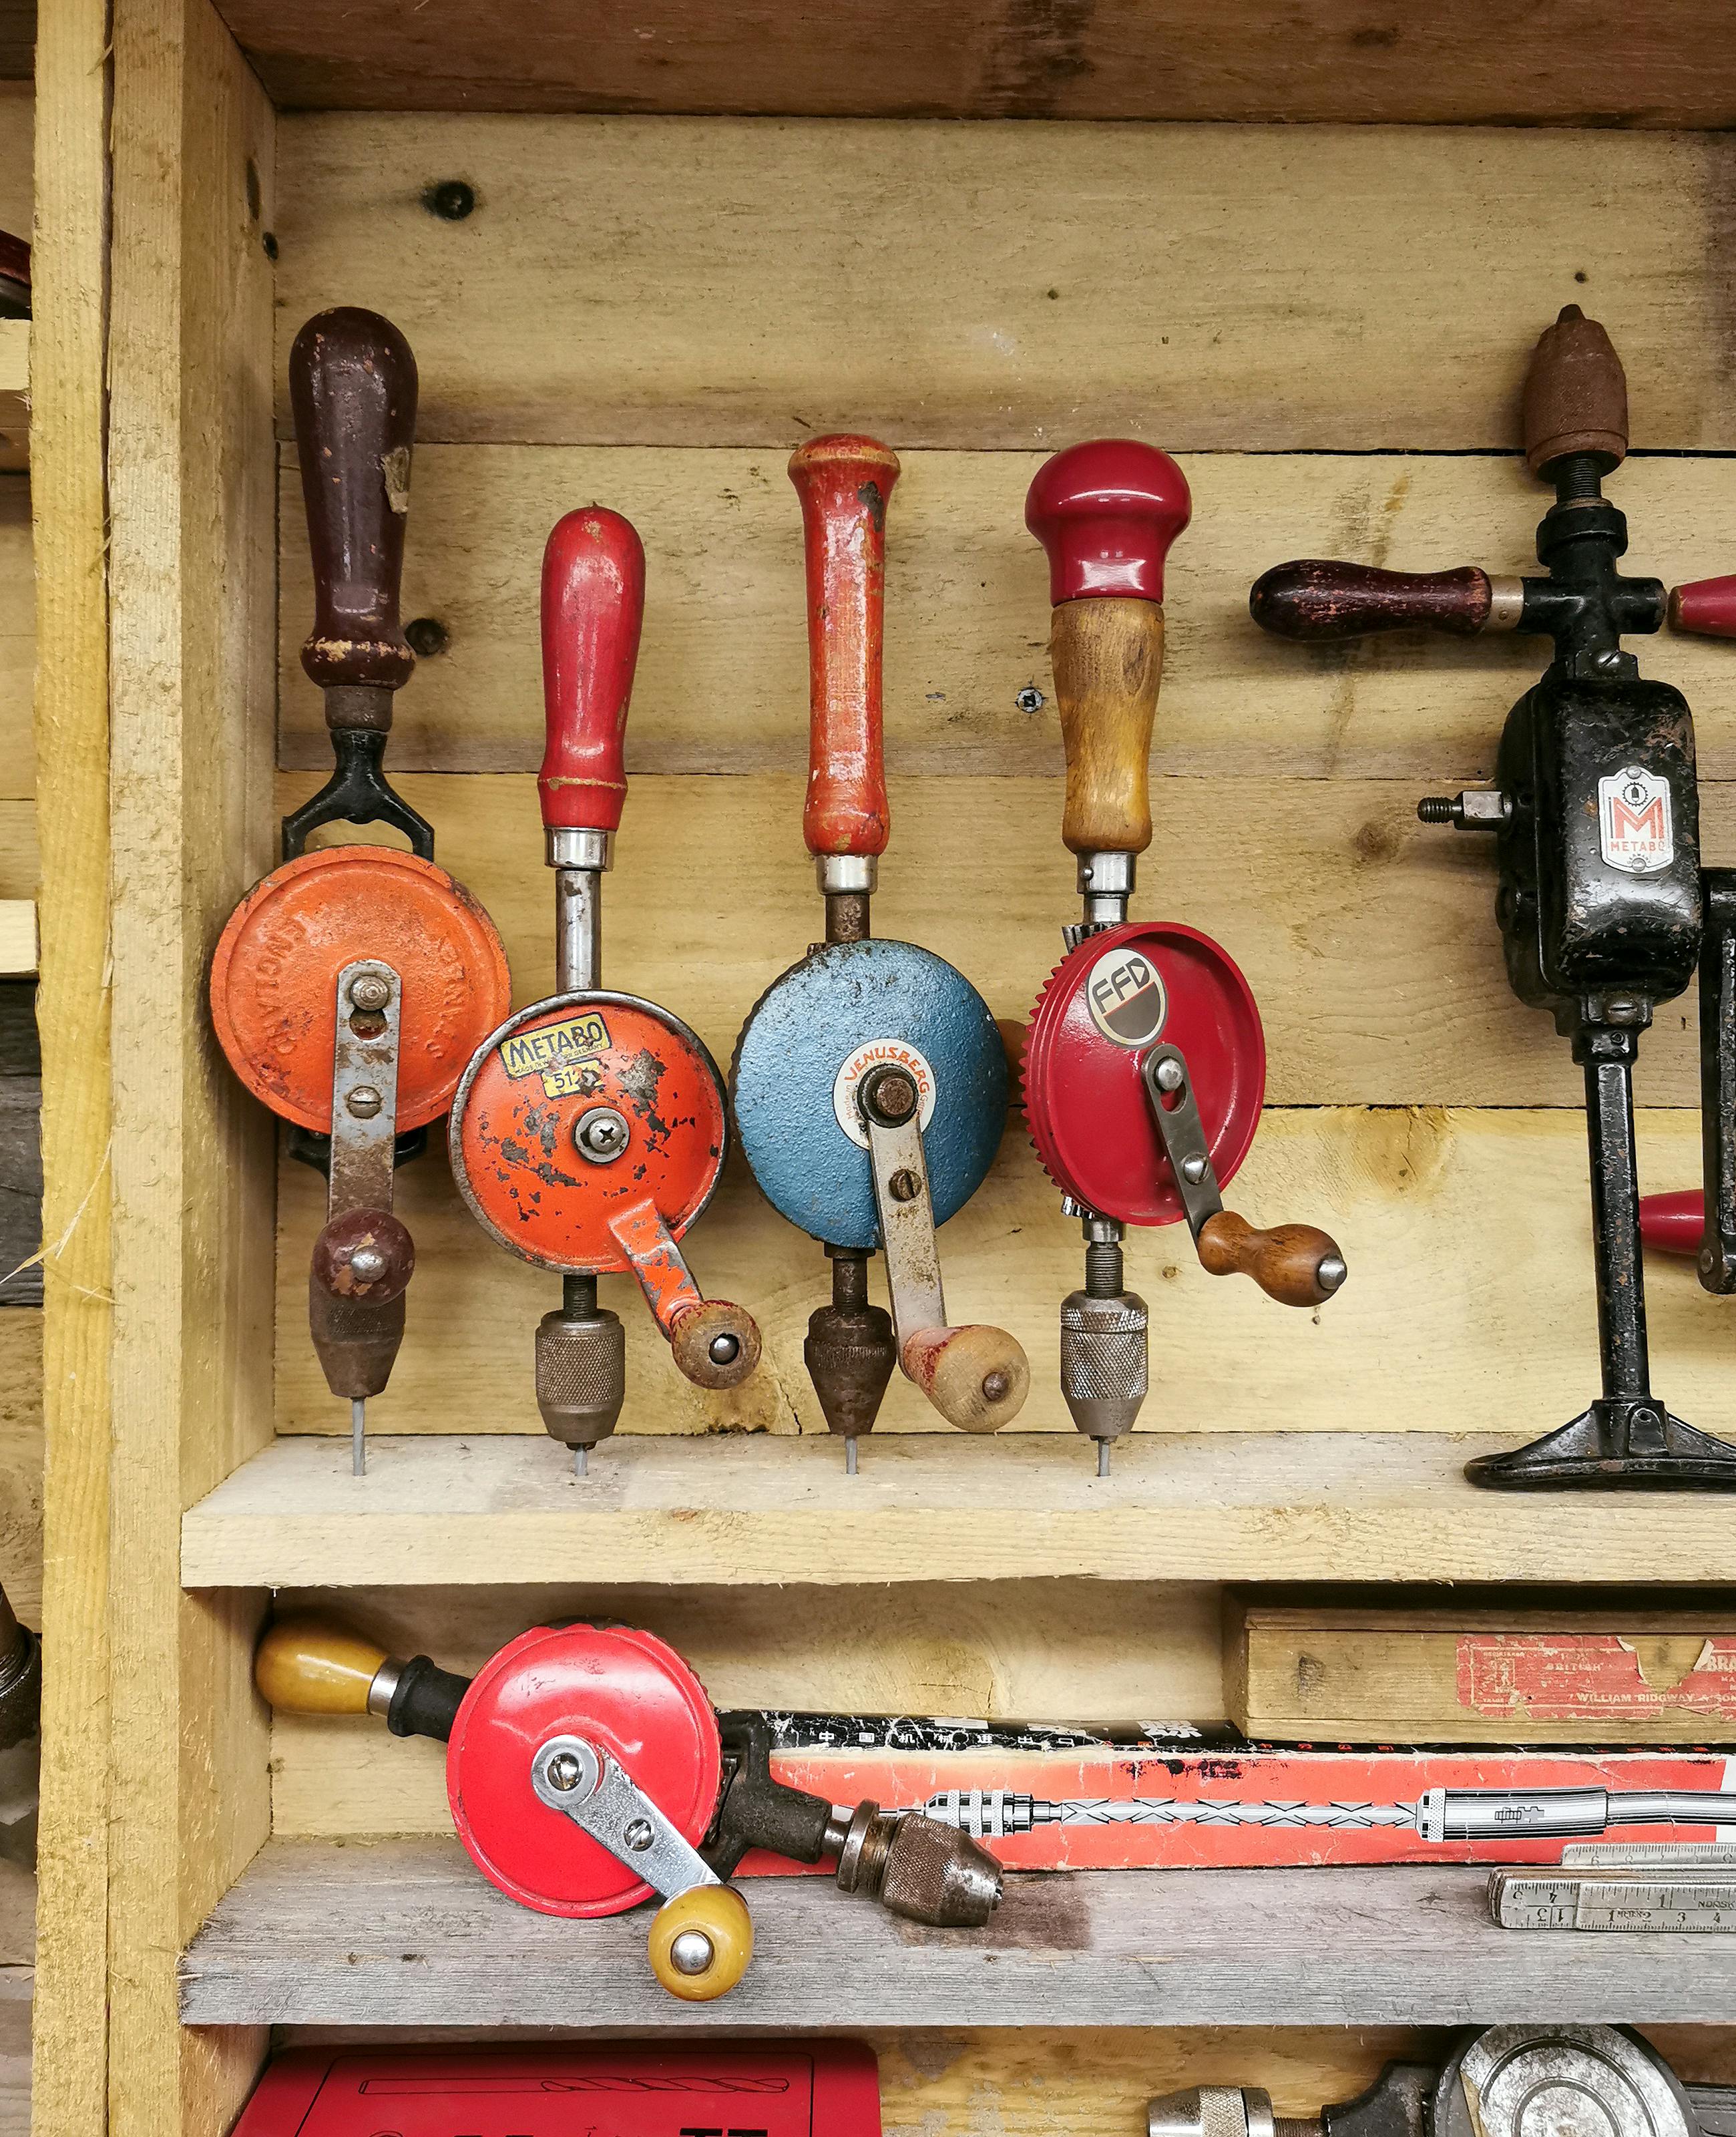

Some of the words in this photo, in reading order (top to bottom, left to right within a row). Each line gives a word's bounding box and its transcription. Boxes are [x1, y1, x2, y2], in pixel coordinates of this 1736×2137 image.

[1610, 841, 1665, 851] METABO
[1092, 958, 1150, 1014] FFD
[509, 1022, 602, 1067] METABO
[844, 1046, 929, 1093] VENUSBERG
[1576, 1694, 1632, 1703] WILLIAM
[1638, 1694, 1695, 1703] RIDGWAY
[1677, 1912, 1686, 1923] 3
[1713, 1912, 1721, 1923] 4
